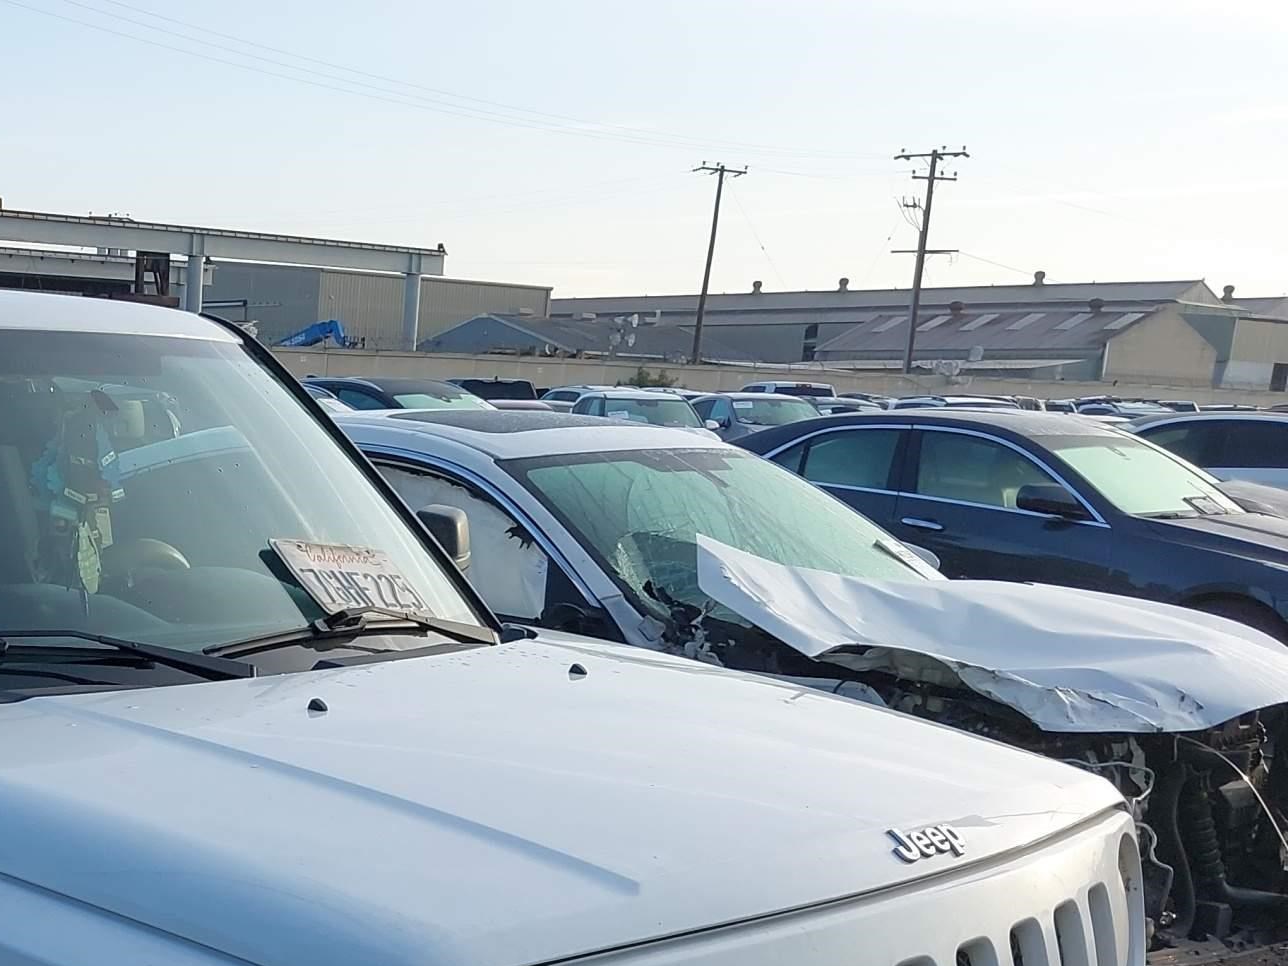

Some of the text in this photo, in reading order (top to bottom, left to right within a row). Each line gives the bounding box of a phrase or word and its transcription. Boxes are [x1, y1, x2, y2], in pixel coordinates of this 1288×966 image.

[304, 543, 370, 568] California
[299, 567, 423, 609] 7GHF225
[884, 824, 968, 863] Jeep
